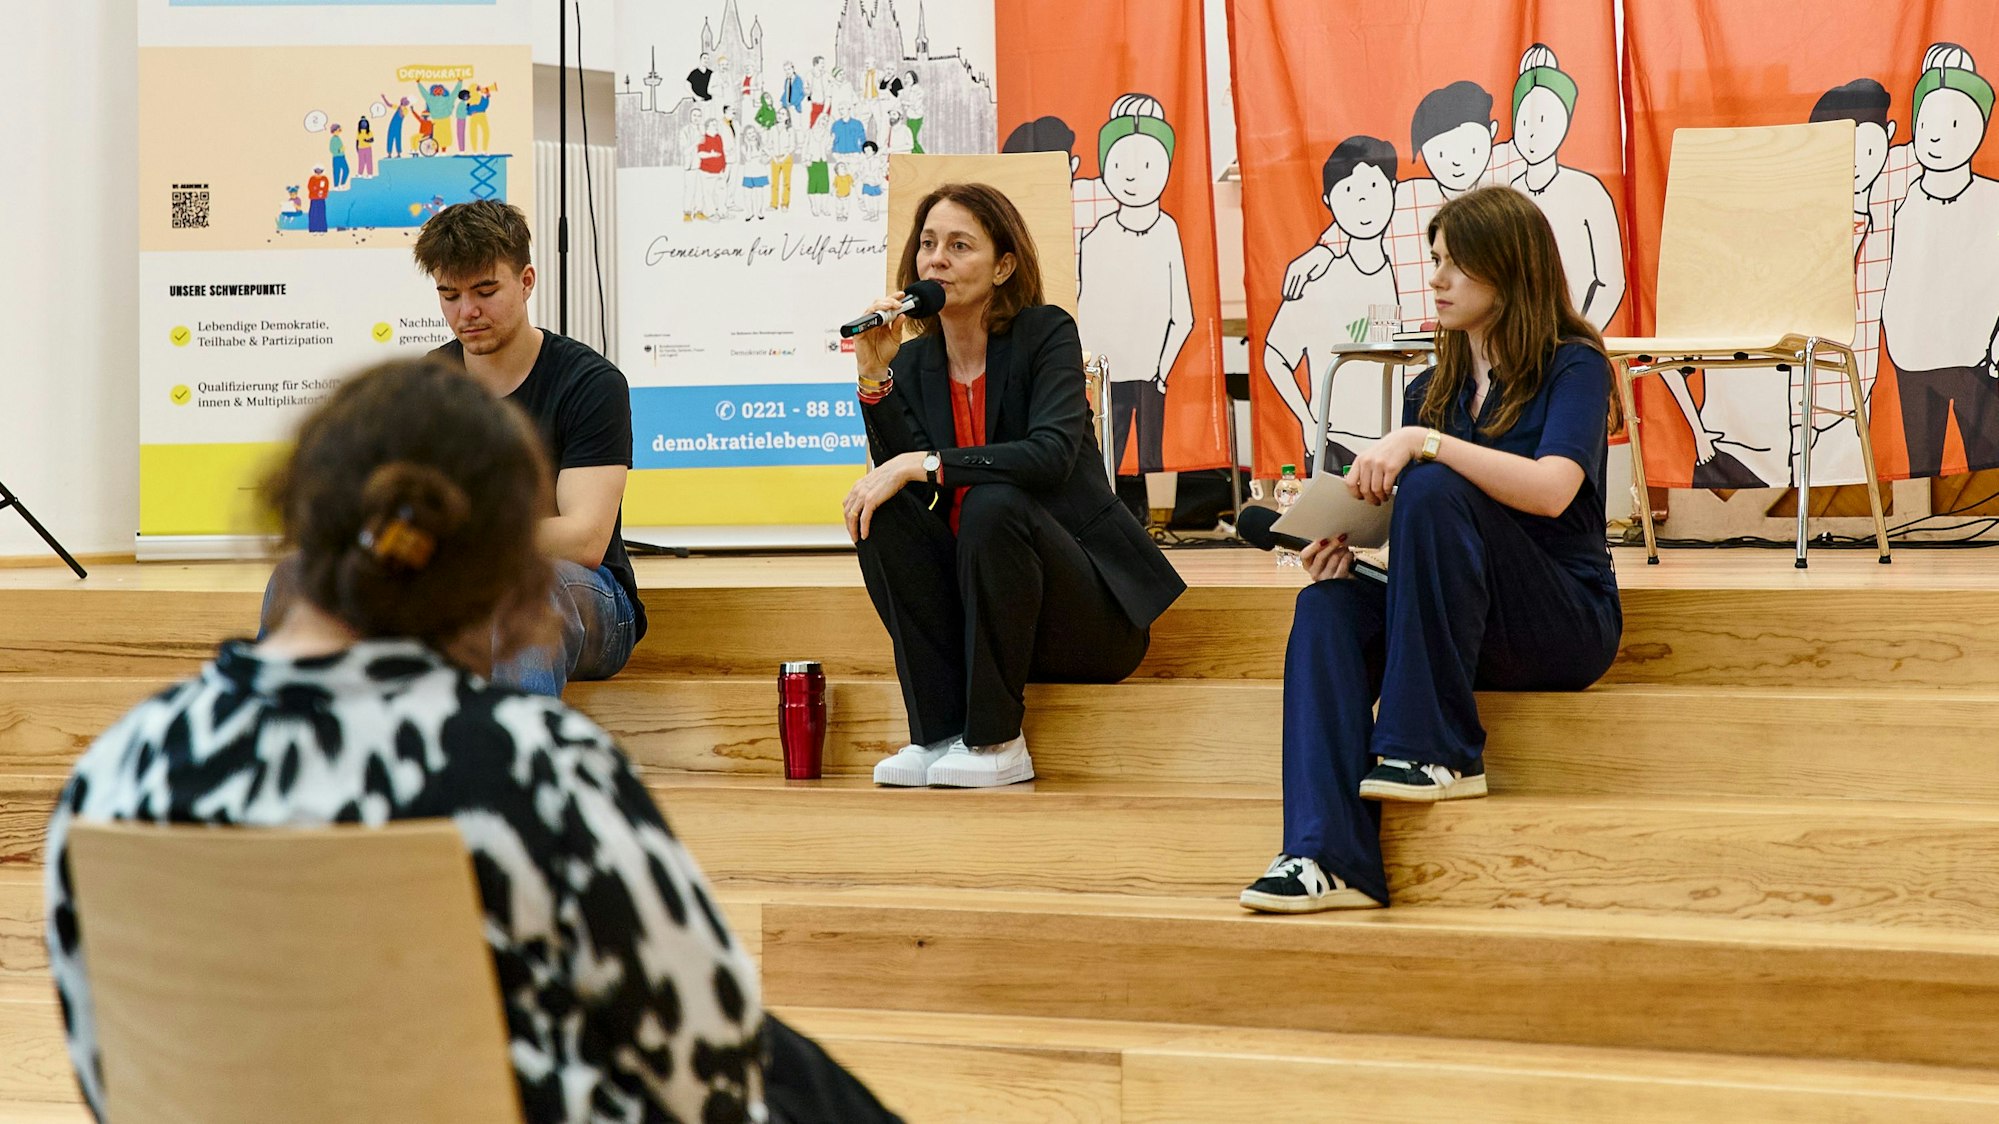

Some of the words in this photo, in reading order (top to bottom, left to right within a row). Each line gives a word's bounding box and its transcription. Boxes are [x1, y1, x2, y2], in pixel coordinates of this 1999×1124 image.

[399, 67, 472, 79] DEMOKRATIE
[645, 235, 745, 267] Gemeinsam
[746, 237, 776, 267] für
[780, 233, 868, 265] Vielfalt
[170, 285, 206, 297] UNSERE
[210, 284, 286, 296] SCHWERPUNKTE
[198, 321, 257, 333] Lebendige
[260, 319, 330, 332] Demokratie,
[198, 336, 246, 347] Teilhabe
[249, 336, 258, 346] &
[262, 334, 333, 347] Partizipation
[399, 333, 448, 345] gerechte
[198, 381, 279, 393] Qualifizierung
[282, 380, 298, 391] für
[198, 397, 231, 408] innen
[234, 396, 243, 407] &
[741, 401, 786, 419] 0221
[806, 401, 829, 418] 88
[835, 400, 856, 417] 81
[652, 431, 867, 452] demokratieleben@aw
